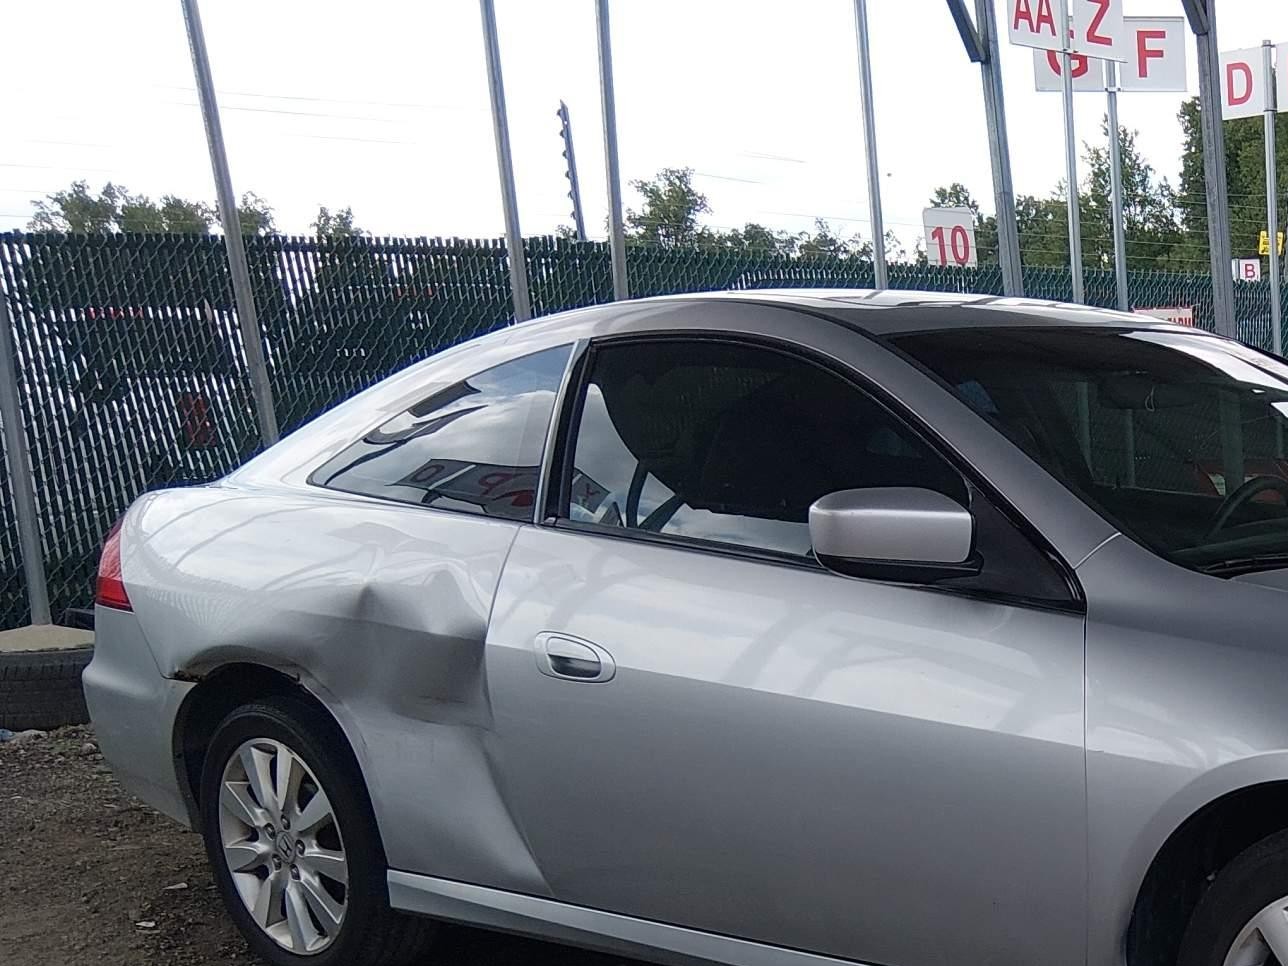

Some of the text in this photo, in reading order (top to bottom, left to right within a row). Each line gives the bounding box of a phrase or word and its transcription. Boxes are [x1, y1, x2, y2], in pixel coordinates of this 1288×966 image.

[1014, 0, 1056, 36] AA
[1086, 0, 1113, 46] Z
[1137, 31, 1166, 78] F
[1227, 62, 1253, 106] D
[931, 225, 970, 267] 10
[1244, 263, 1256, 279] B
